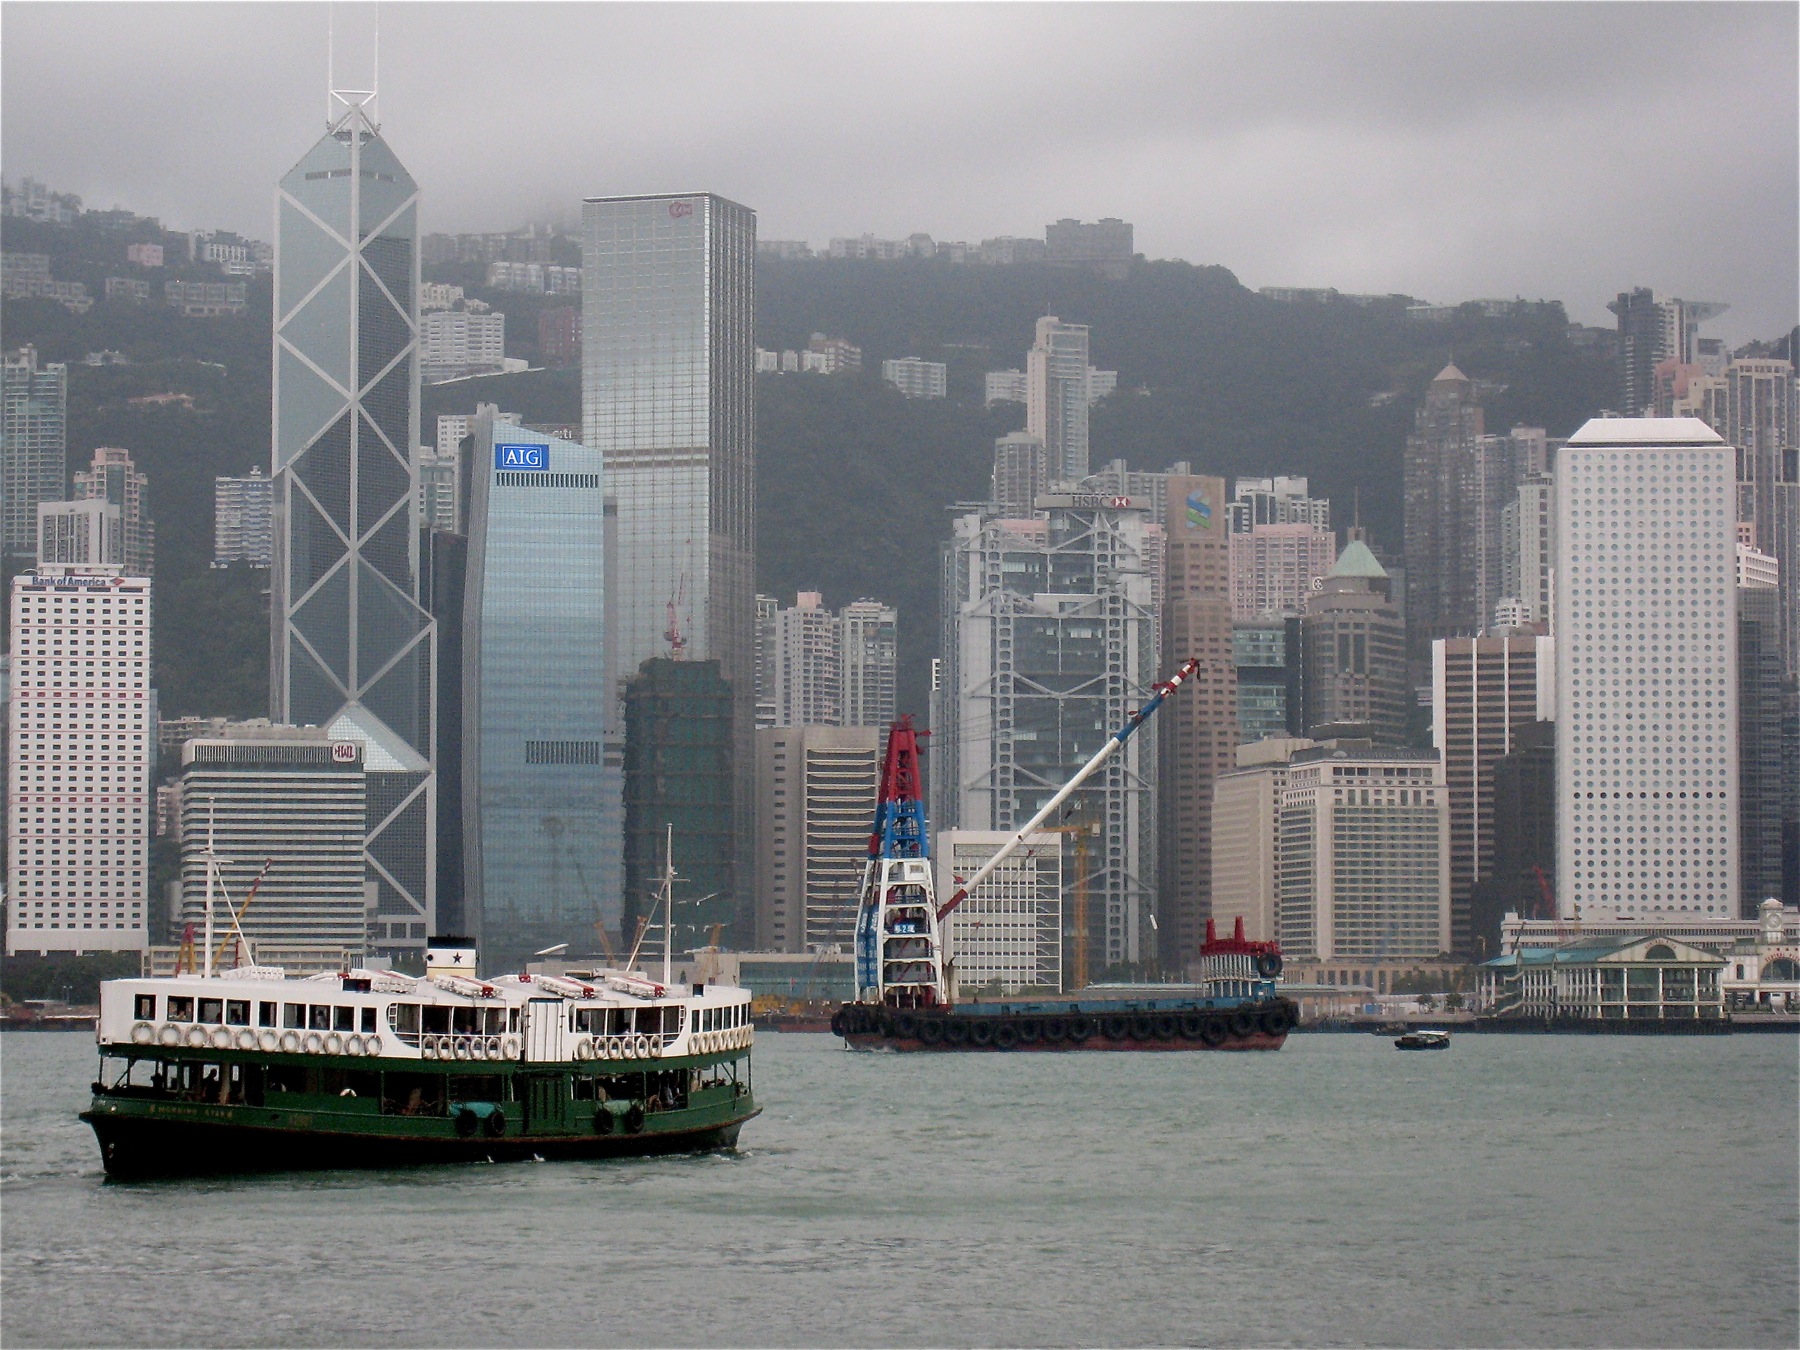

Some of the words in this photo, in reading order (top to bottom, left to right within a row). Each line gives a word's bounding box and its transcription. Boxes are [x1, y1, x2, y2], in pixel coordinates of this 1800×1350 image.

[505, 449, 539, 465] AIG
[1072, 495, 1109, 509] HSBC
[32, 576, 55, 586] Bank
[57, 576, 66, 586] of
[67, 577, 106, 587] America
